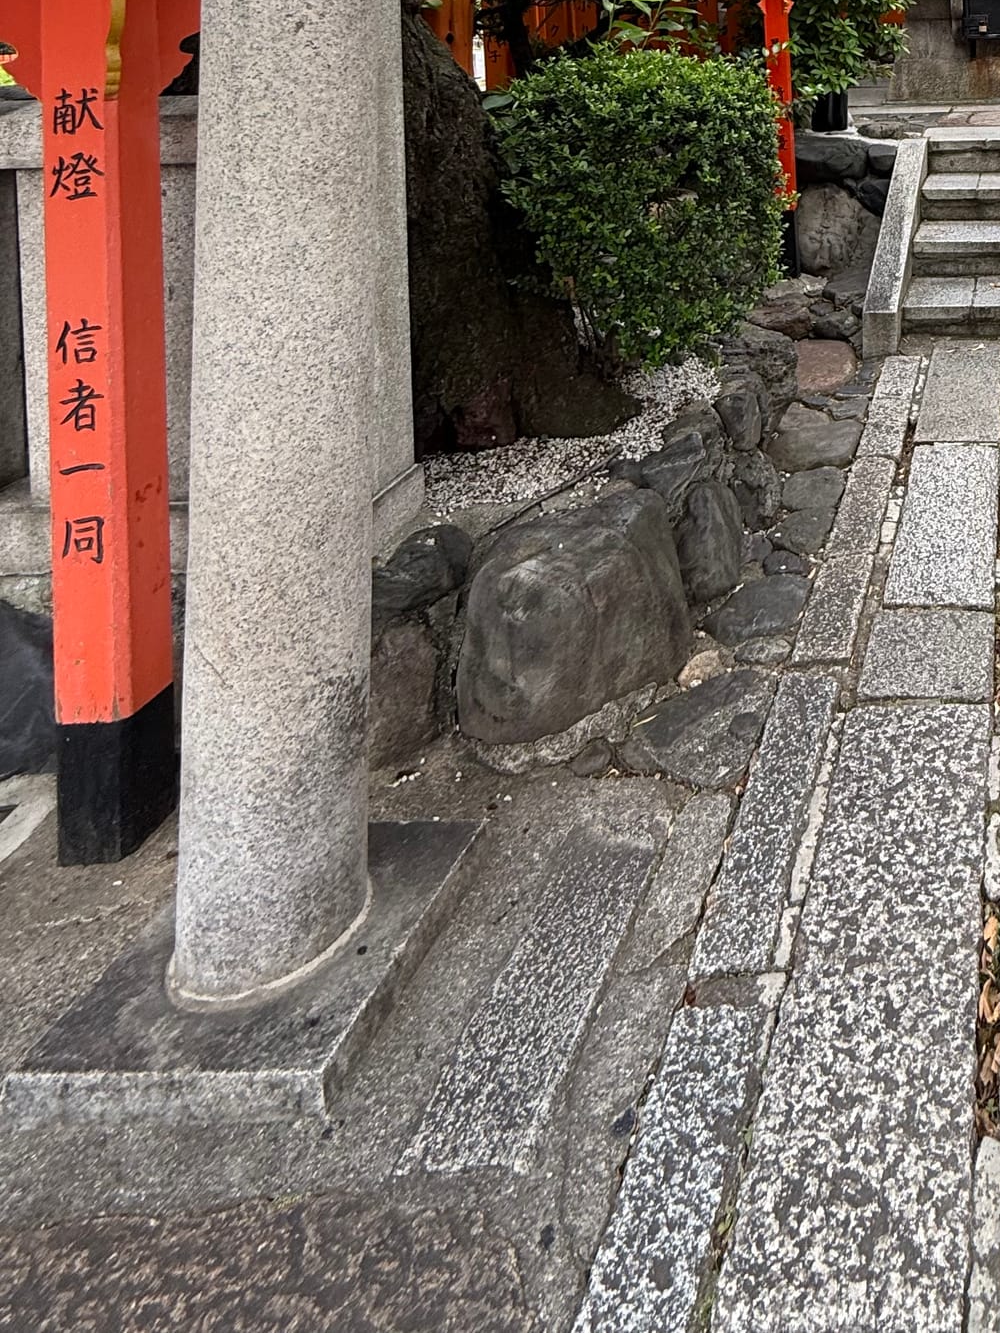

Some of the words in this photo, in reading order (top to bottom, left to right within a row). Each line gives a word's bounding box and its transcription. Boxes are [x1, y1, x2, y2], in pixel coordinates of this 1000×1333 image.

[49, 88, 105, 200] 献燈
[55, 318, 105, 565] 信者一同
